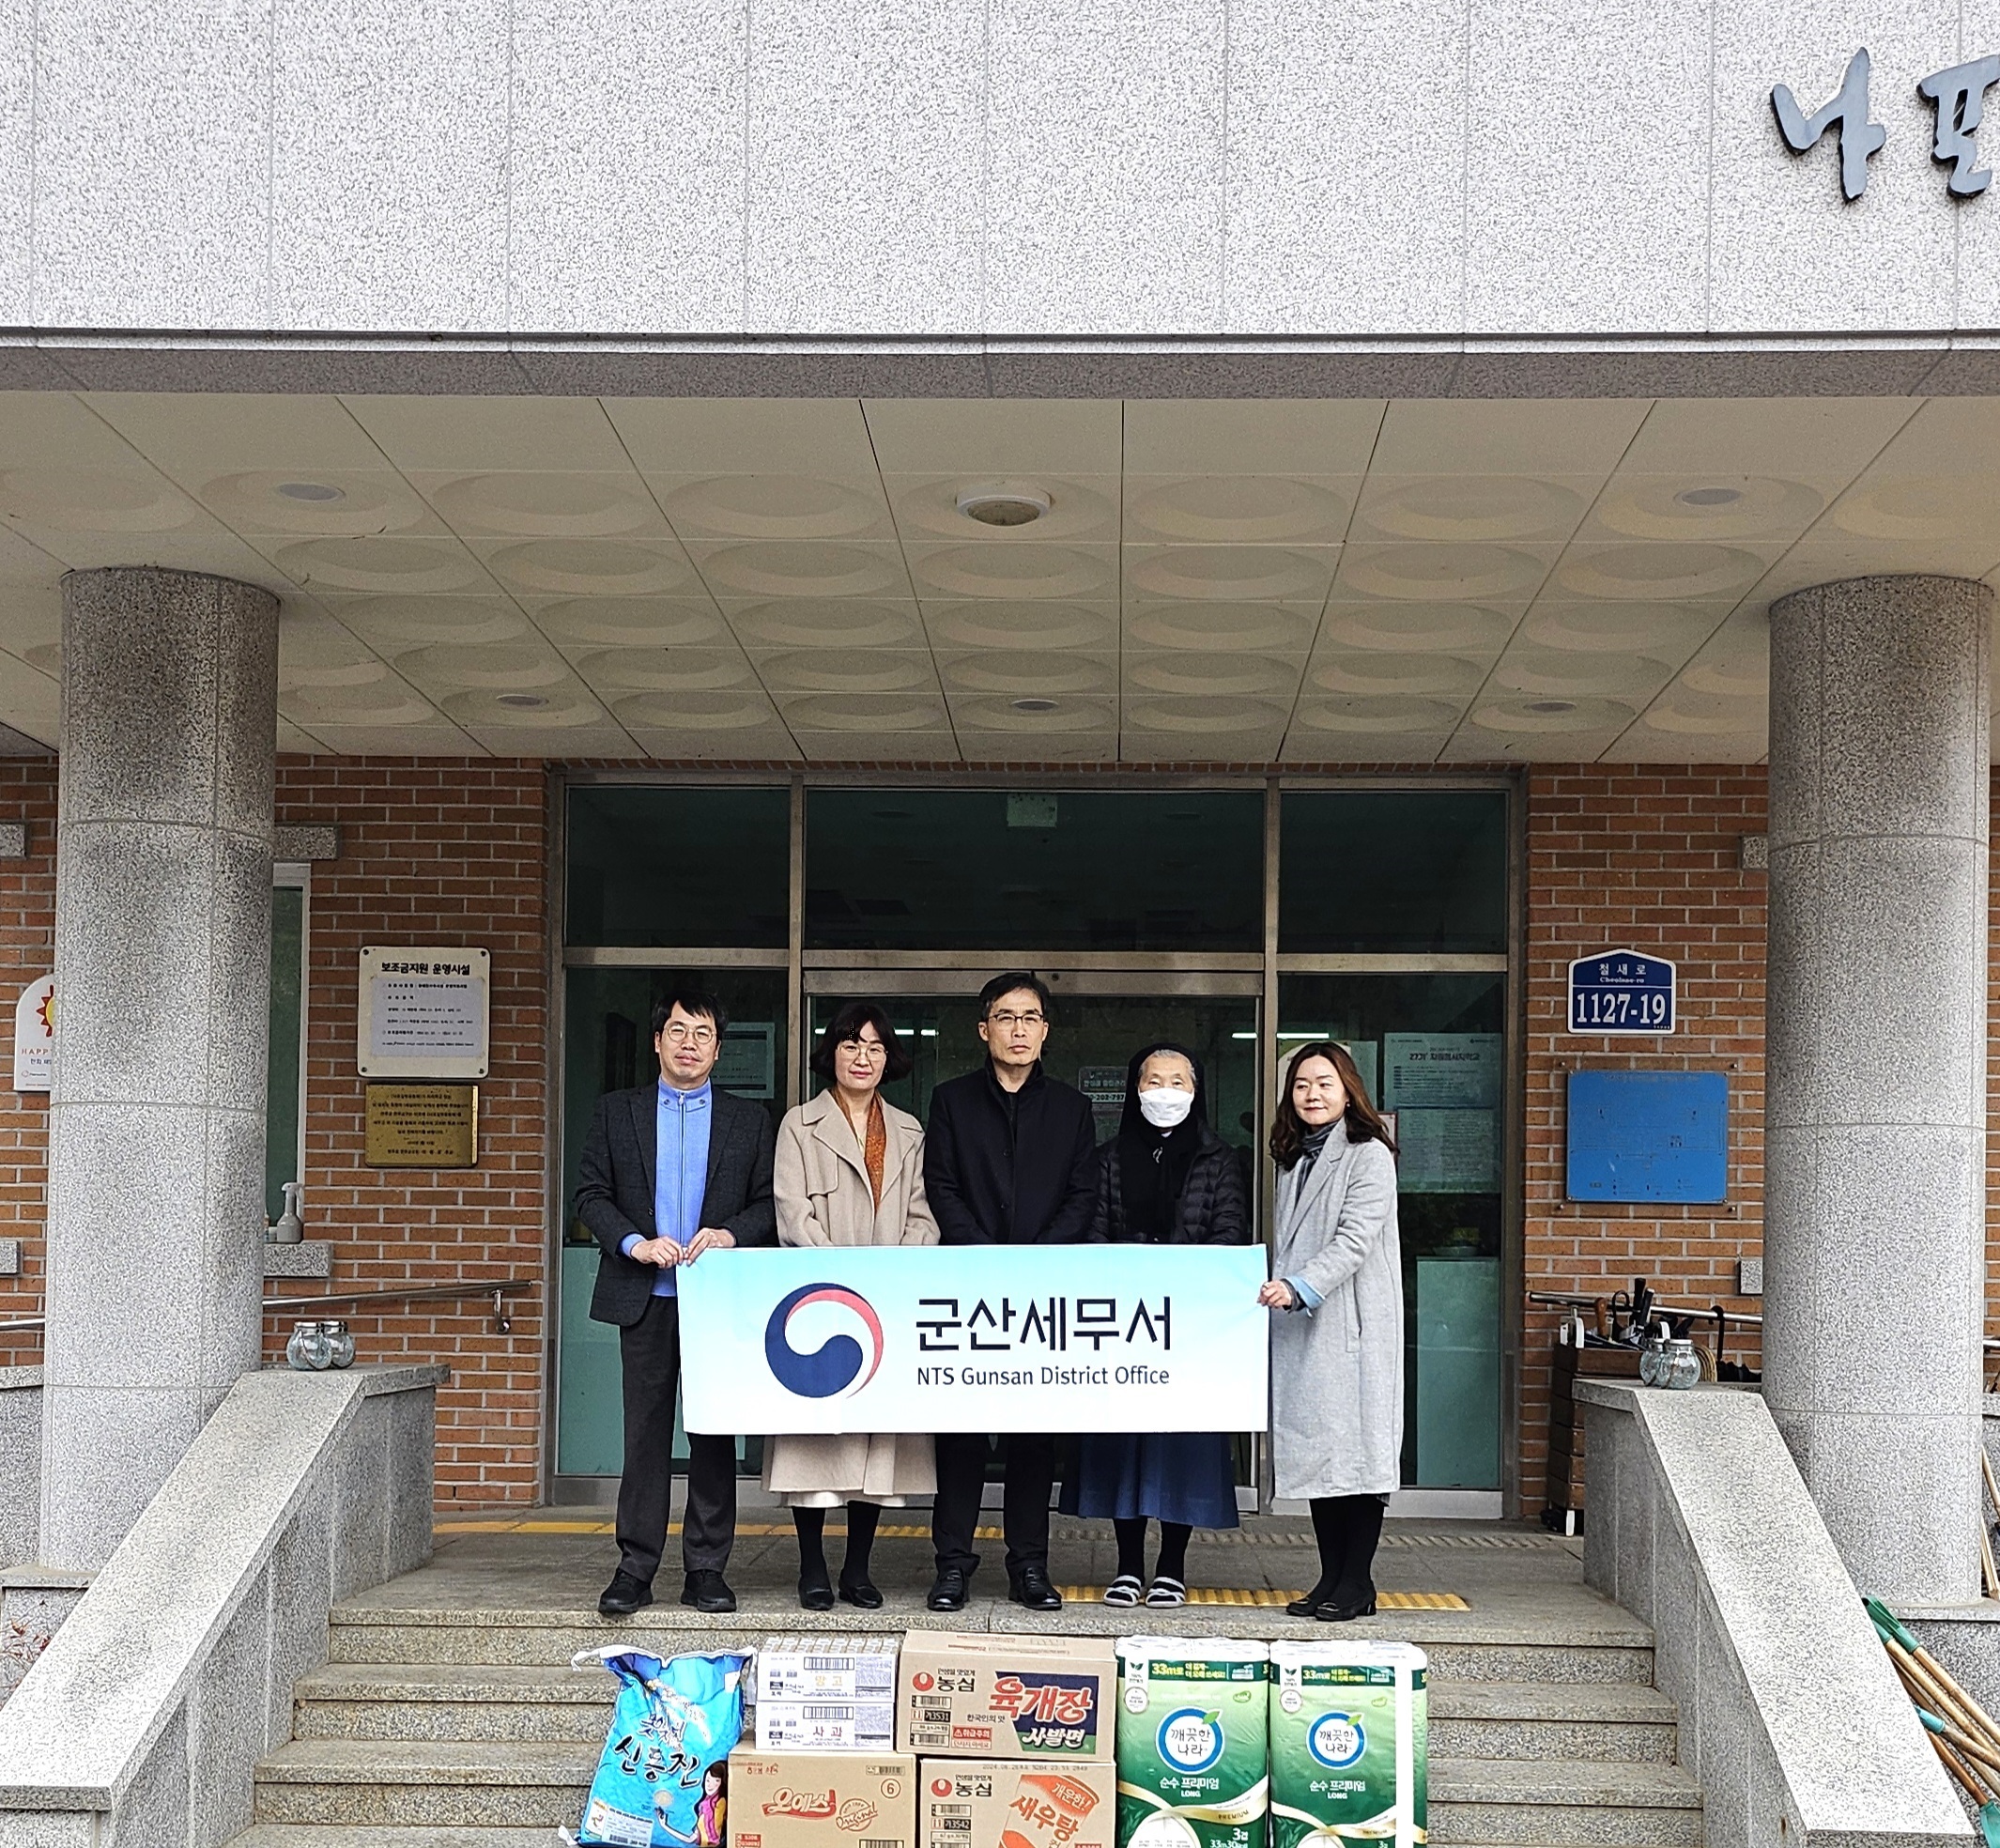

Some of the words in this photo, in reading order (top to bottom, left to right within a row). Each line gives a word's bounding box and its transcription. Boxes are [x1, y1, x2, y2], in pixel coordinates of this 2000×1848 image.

[381, 962, 429, 974] 보조금지원
[433, 963, 470, 976] 운영시설
[1599, 962, 1646, 976] 철새로
[1577, 993, 1666, 1024] 1127-19
[915, 1296, 1171, 1351] 군산세무서
[917, 1367, 955, 1385] NTS
[962, 1367, 1034, 1385] Gunsan
[1041, 1365, 1108, 1385] District
[1115, 1365, 1170, 1385] Office
[937, 1676, 975, 1692] 농심
[989, 1677, 1092, 1722] 육개장
[813, 1726, 843, 1737] 사과
[1022, 1727, 1085, 1748] 사발면
[1171, 1727, 1211, 1742] 깨끗한
[1319, 1729, 1354, 1742] 깨끗한
[1177, 1744, 1203, 1757] 나라
[1326, 1743, 1347, 1754] 나라
[955, 1781, 992, 1797] 농심
[1160, 1777, 1180, 1789] 순수
[1181, 1777, 1220, 1790] 프리미엄
[1310, 1780, 1329, 1791] 순수
[1330, 1780, 1366, 1792] 프리미엄
[766, 1786, 831, 1813] 오예스
[1052, 1782, 1092, 1811] 개운한!
[836, 1800, 878, 1830] Original
[1008, 1794, 1079, 1842] 새우탕
[1218, 1810, 1250, 1820] PREMIUM
